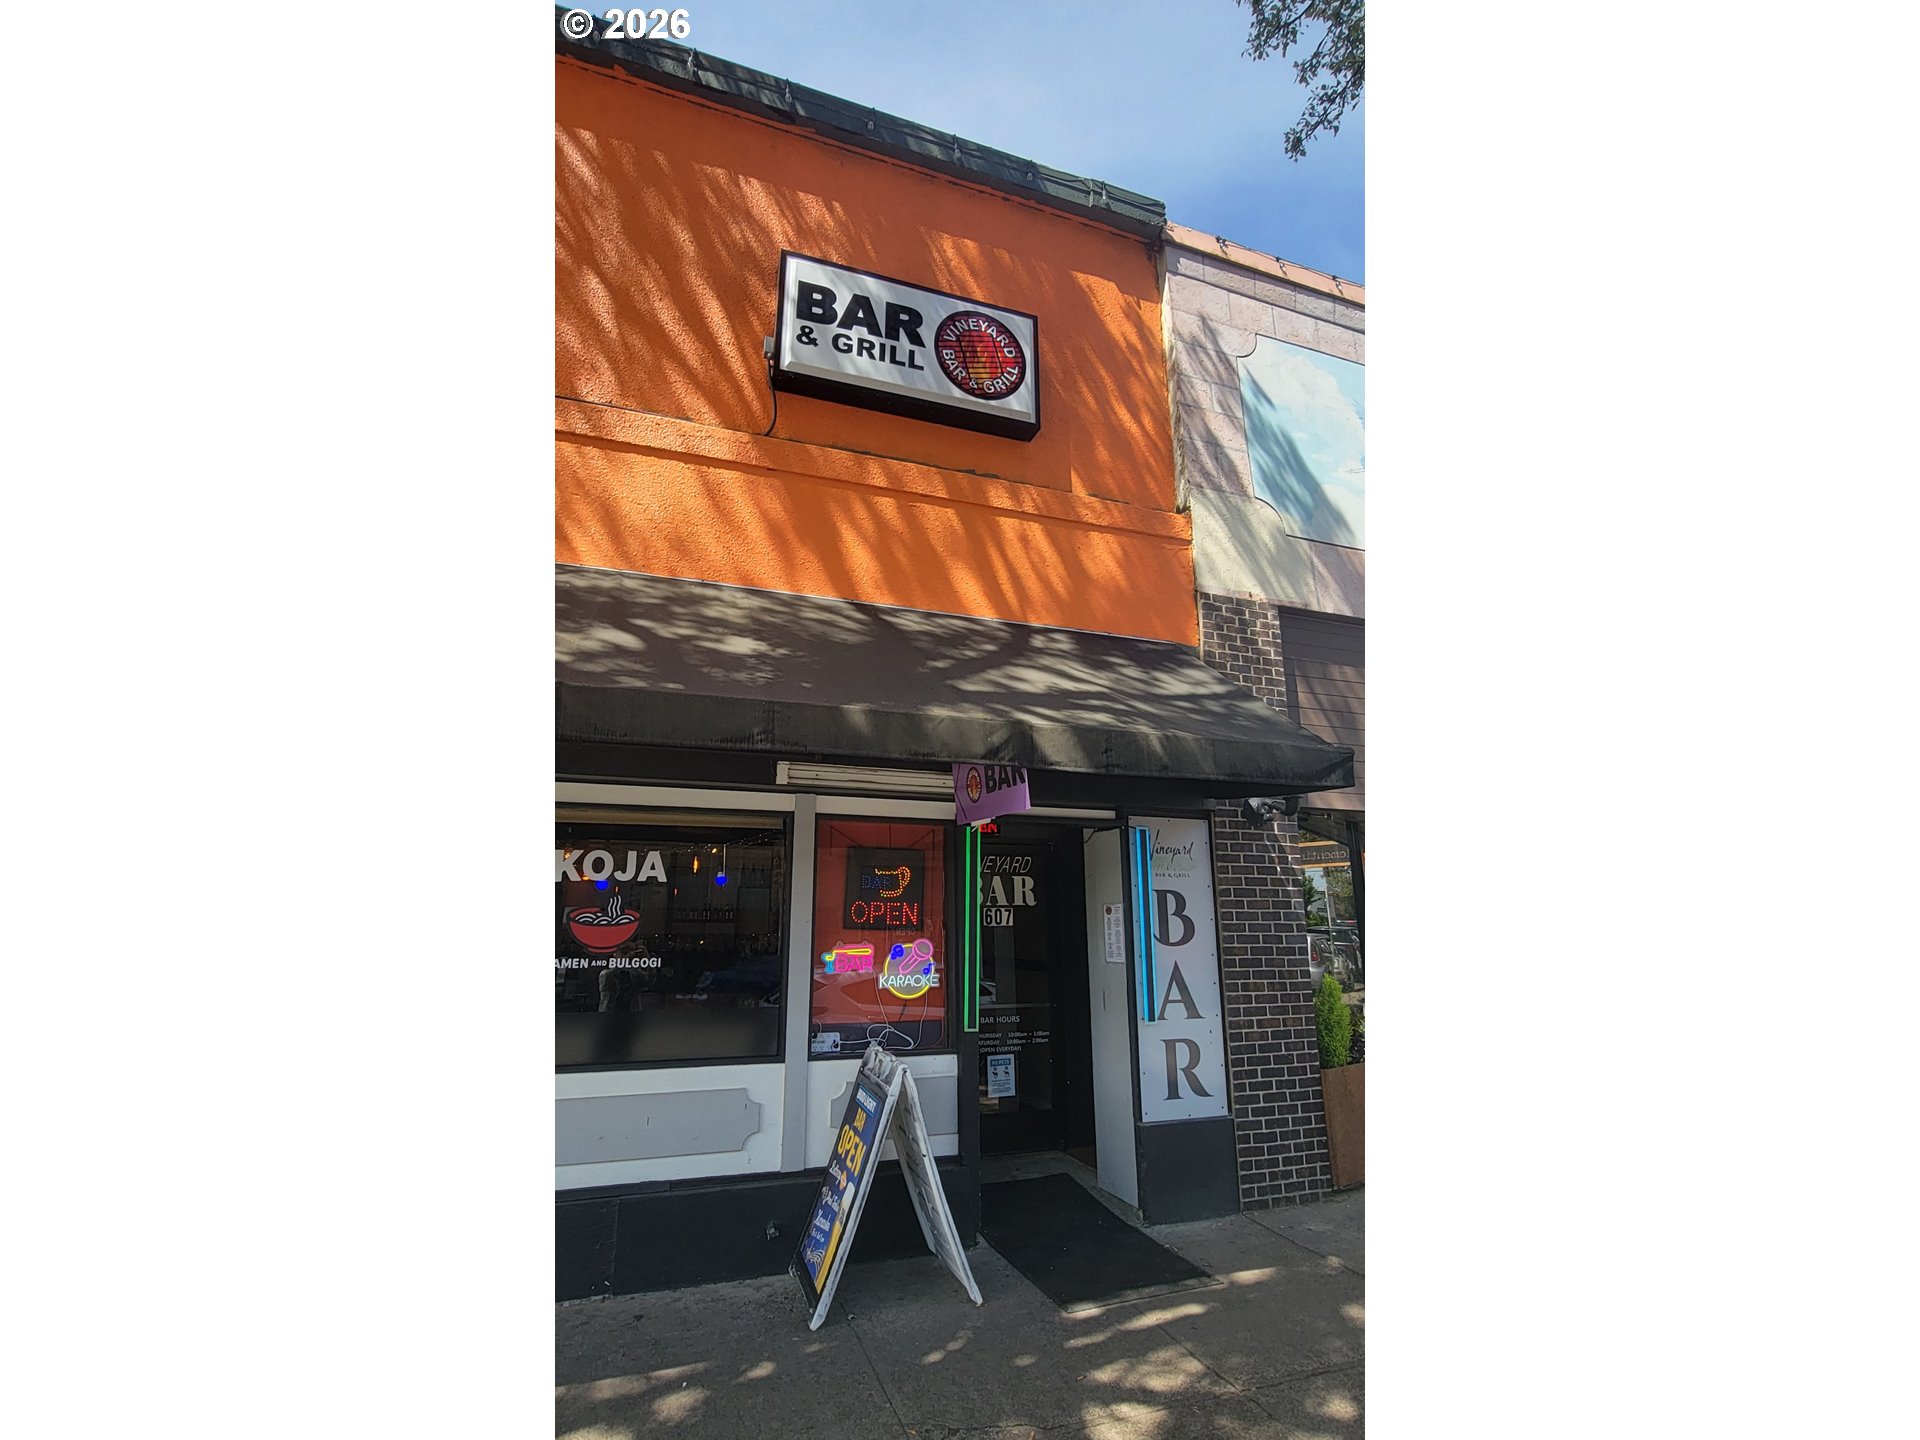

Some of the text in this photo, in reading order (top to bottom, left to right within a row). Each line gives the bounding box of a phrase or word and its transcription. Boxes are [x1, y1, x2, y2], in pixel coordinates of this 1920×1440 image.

[796, 280, 926, 348] BAR
[796, 325, 924, 371] & GRILL
[943, 318, 1016, 358] VINEYARD
[942, 349, 1019, 394] BAR & GRILL
[984, 765, 1026, 794] BAR
[555, 850, 667, 882] KOJA
[980, 856, 1032, 873] EYARD
[851, 901, 918, 925] OPEN
[984, 908, 1013, 926] 607
[555, 958, 589, 969] AMEN
[608, 957, 662, 969] BULGOGI
[836, 955, 874, 973] BAR
[879, 974, 940, 989] KARAOKE
[980, 1015, 1020, 1024] BAR HOURS
[837, 1124, 866, 1177] OPEN
